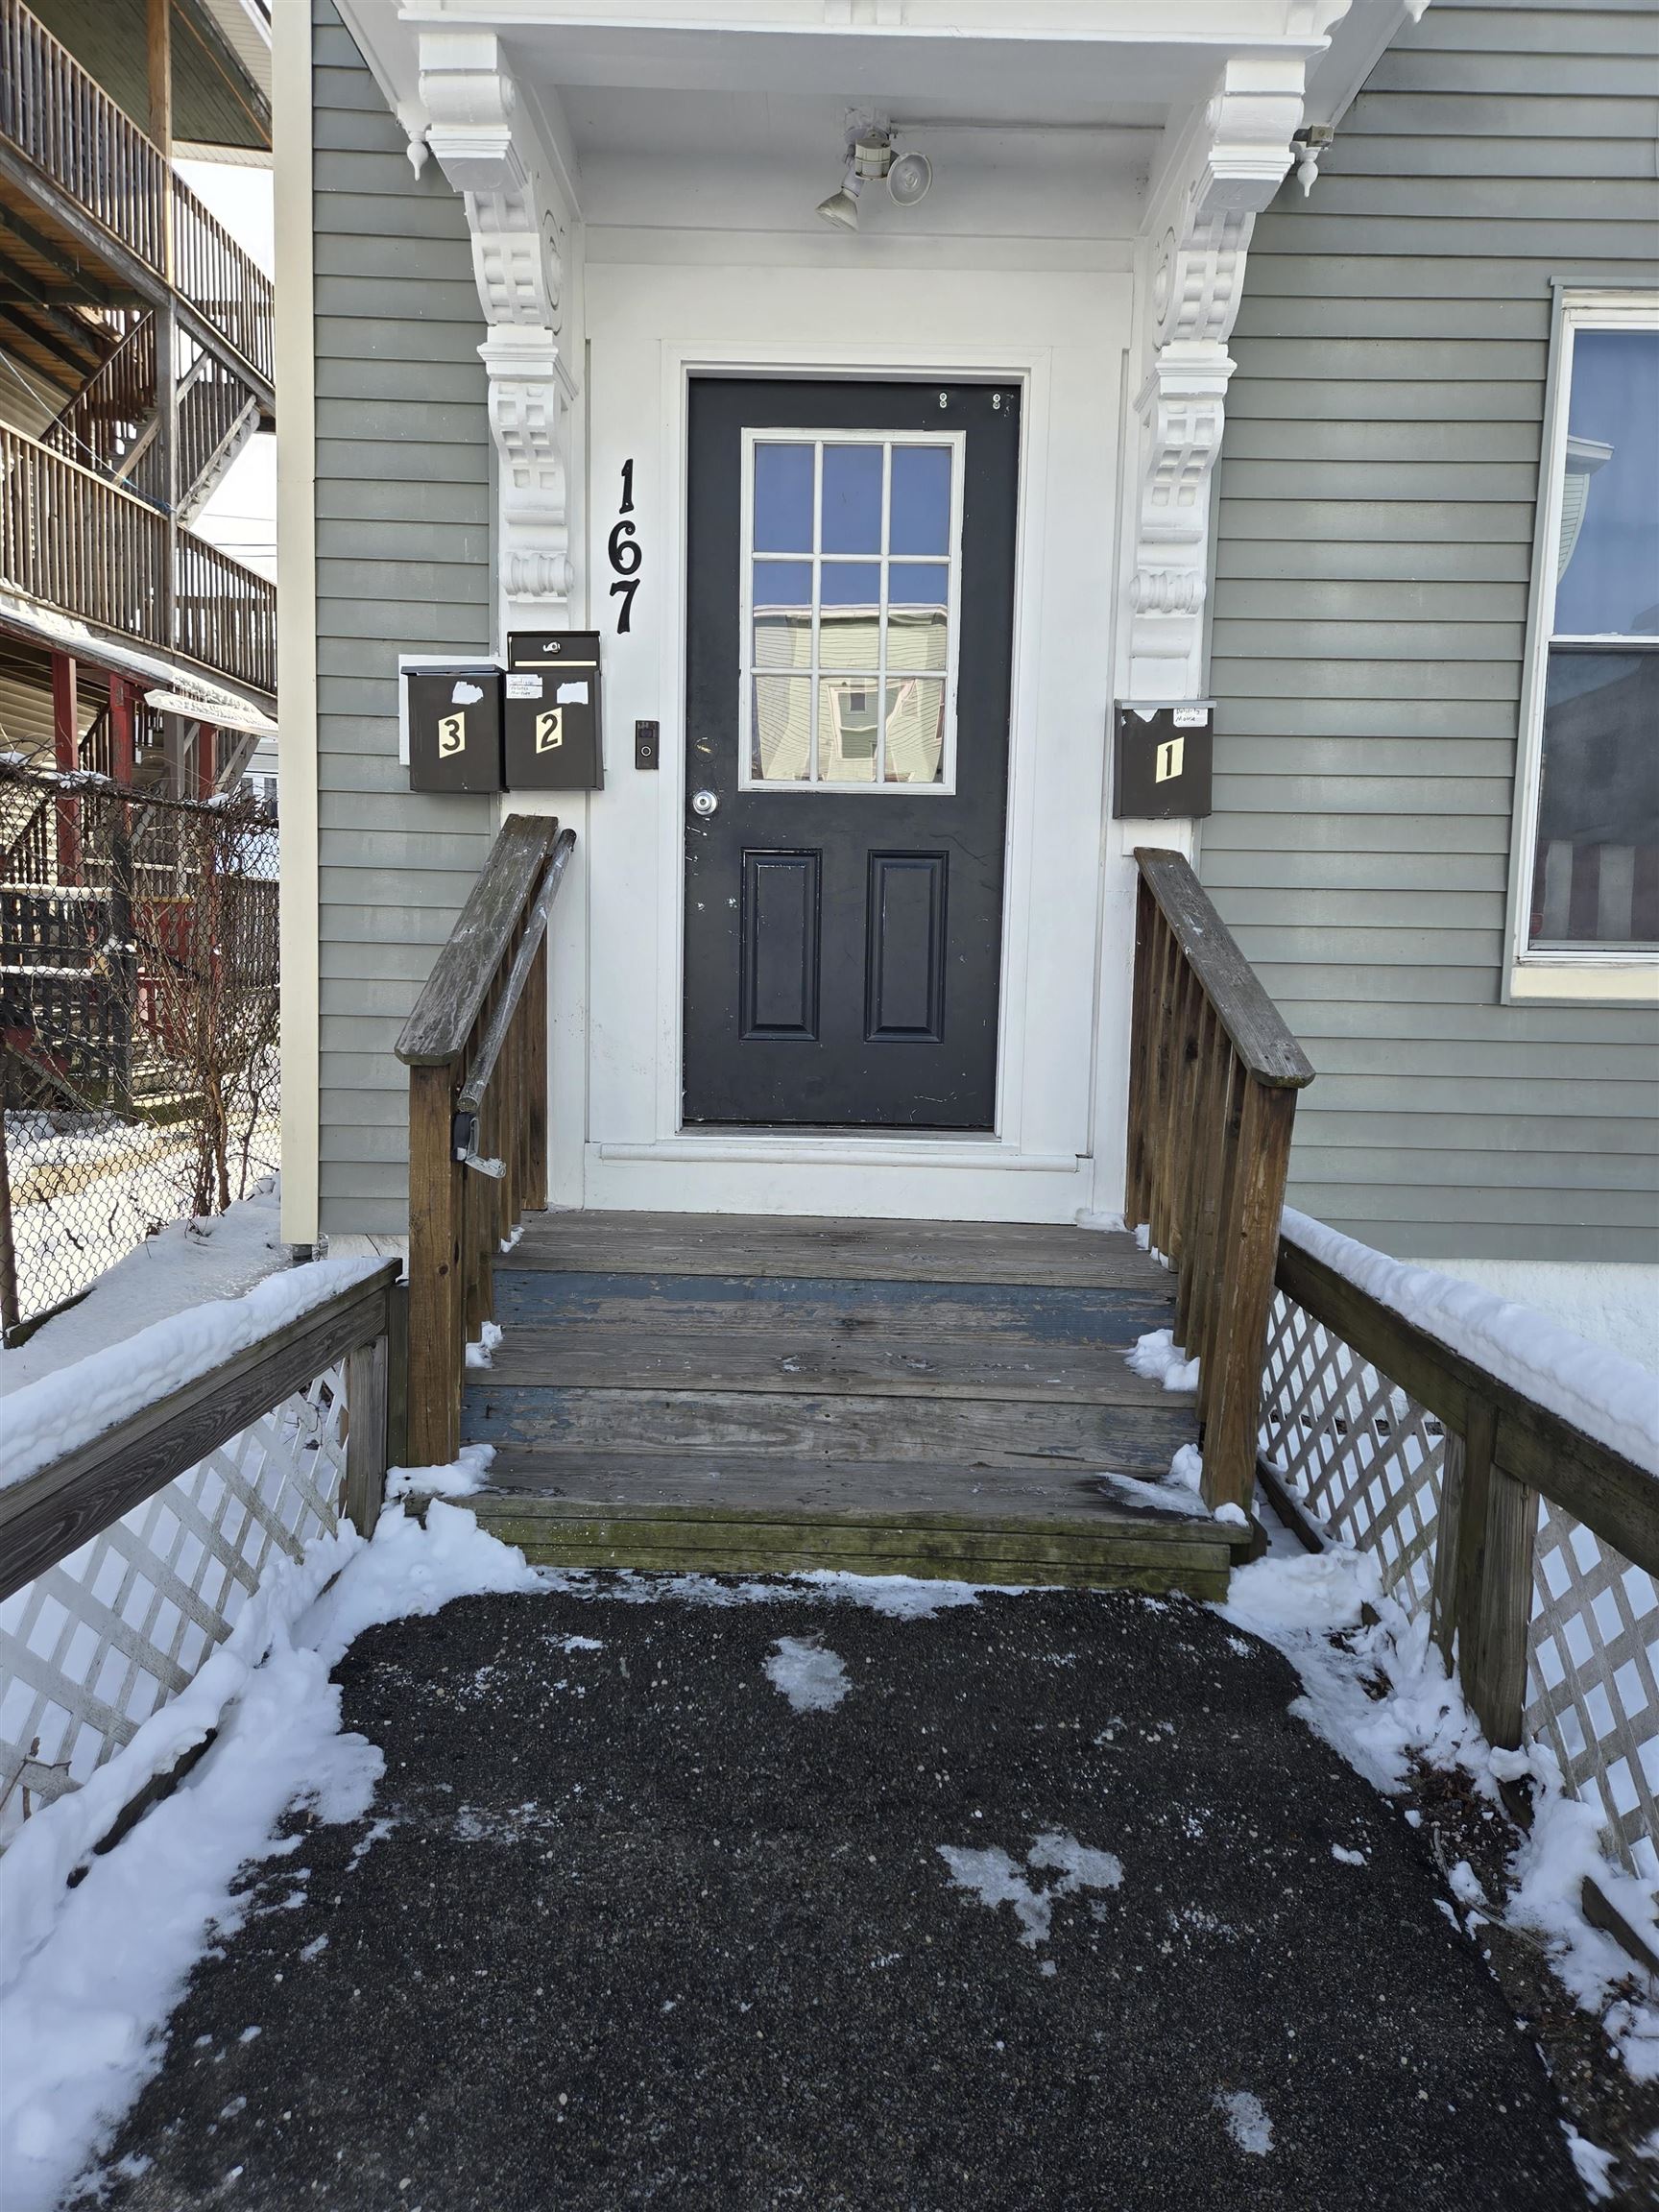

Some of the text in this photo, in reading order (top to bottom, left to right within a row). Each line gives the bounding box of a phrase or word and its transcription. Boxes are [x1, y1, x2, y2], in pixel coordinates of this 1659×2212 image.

[608, 458, 642, 635] 167
[442, 718, 461, 752] 3
[541, 713, 559, 749] 2
[1166, 743, 1173, 777] 1
